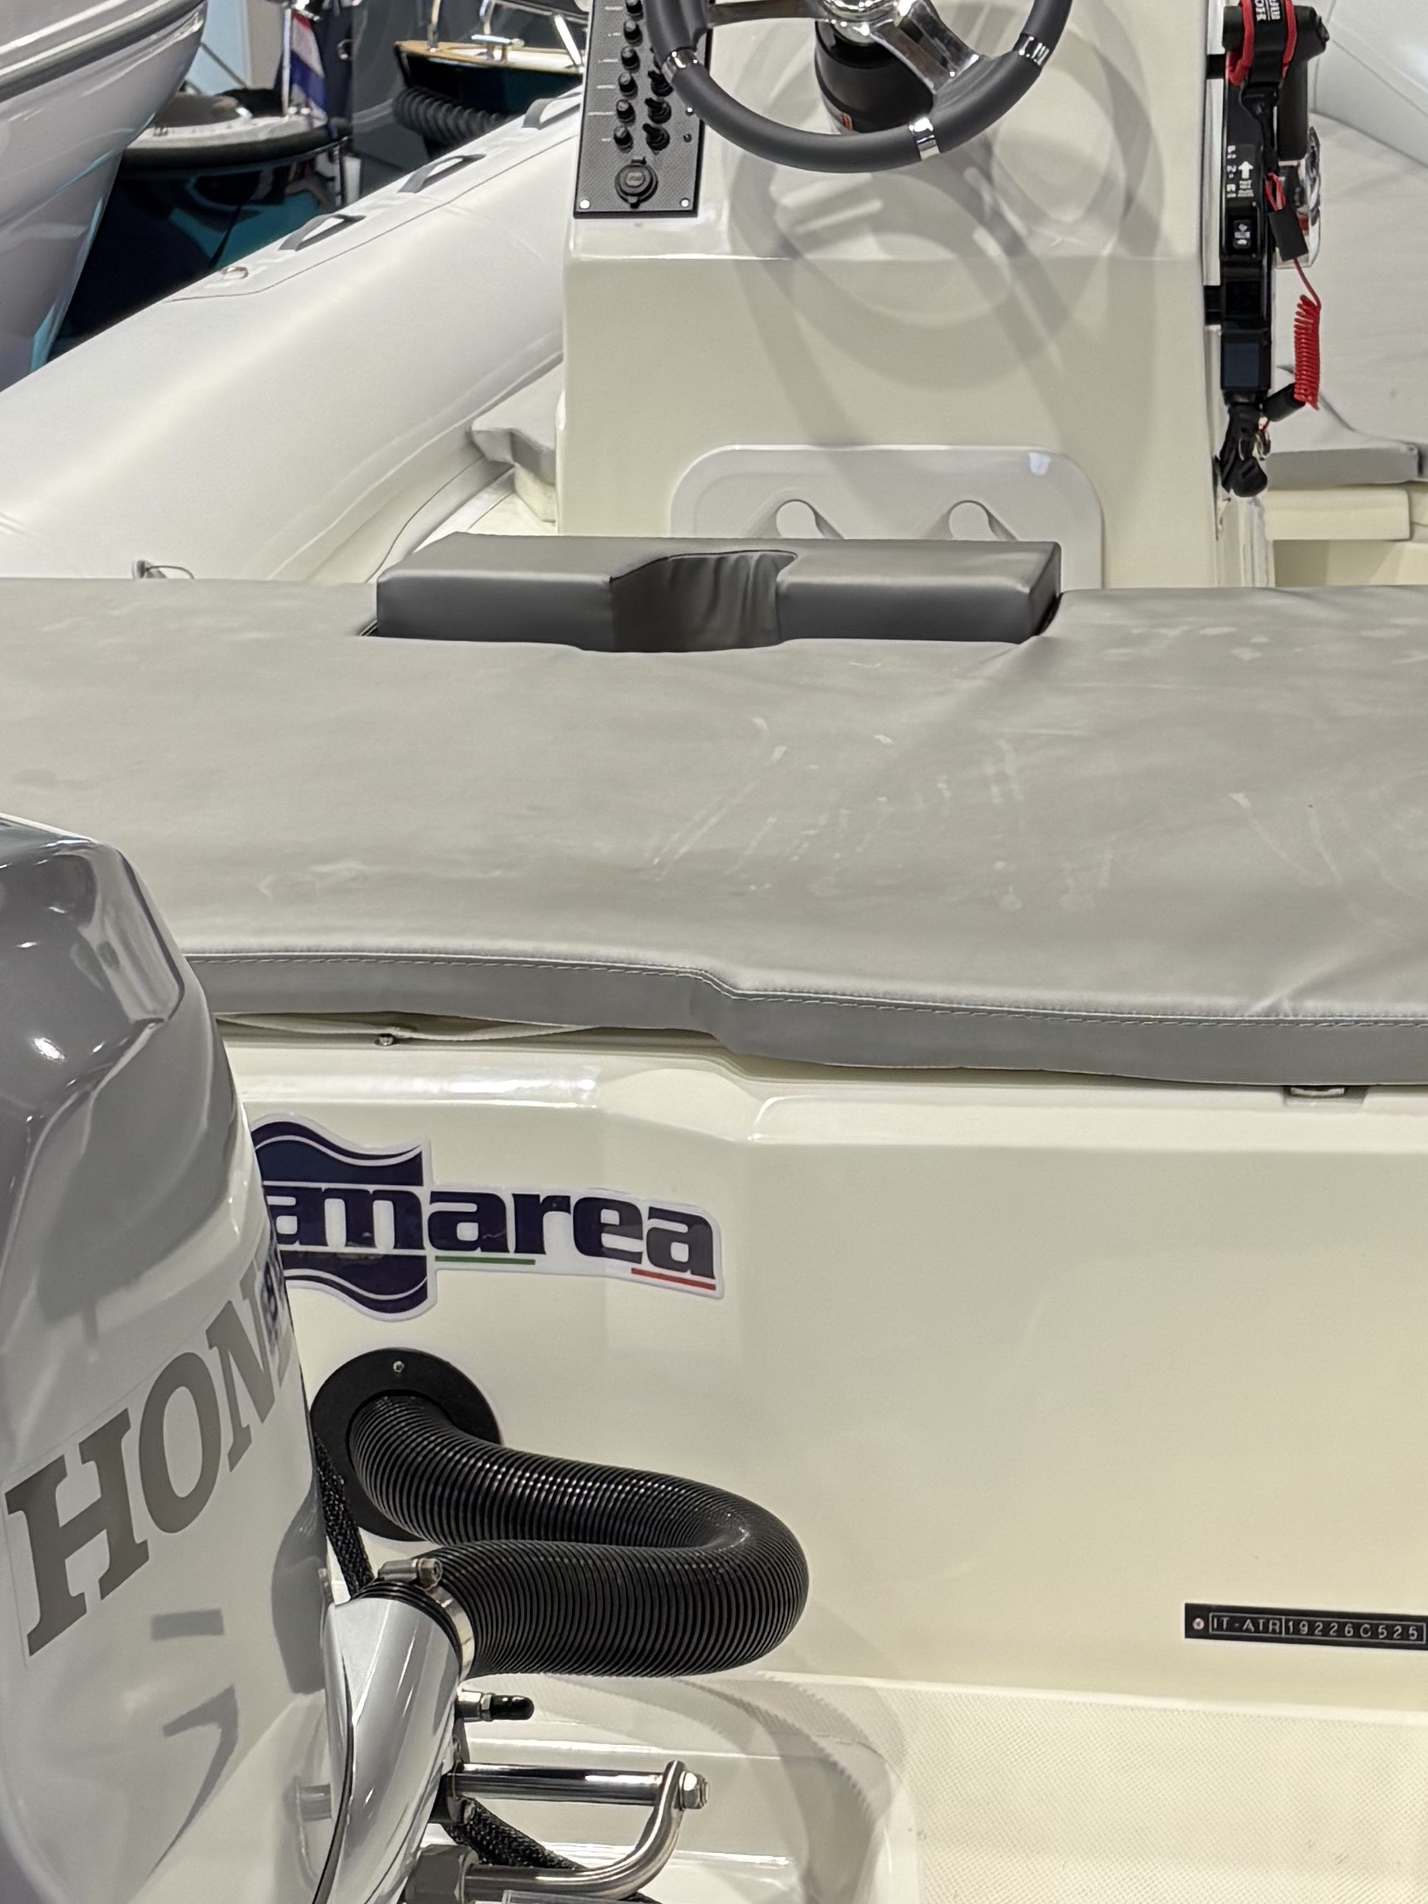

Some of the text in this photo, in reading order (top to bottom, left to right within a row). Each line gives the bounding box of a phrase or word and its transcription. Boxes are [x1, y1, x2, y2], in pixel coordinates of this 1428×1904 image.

[264, 1184, 717, 1280] amarea
[4, 1276, 290, 1658] HON
[1287, 1619, 1420, 1641] 19226C525
